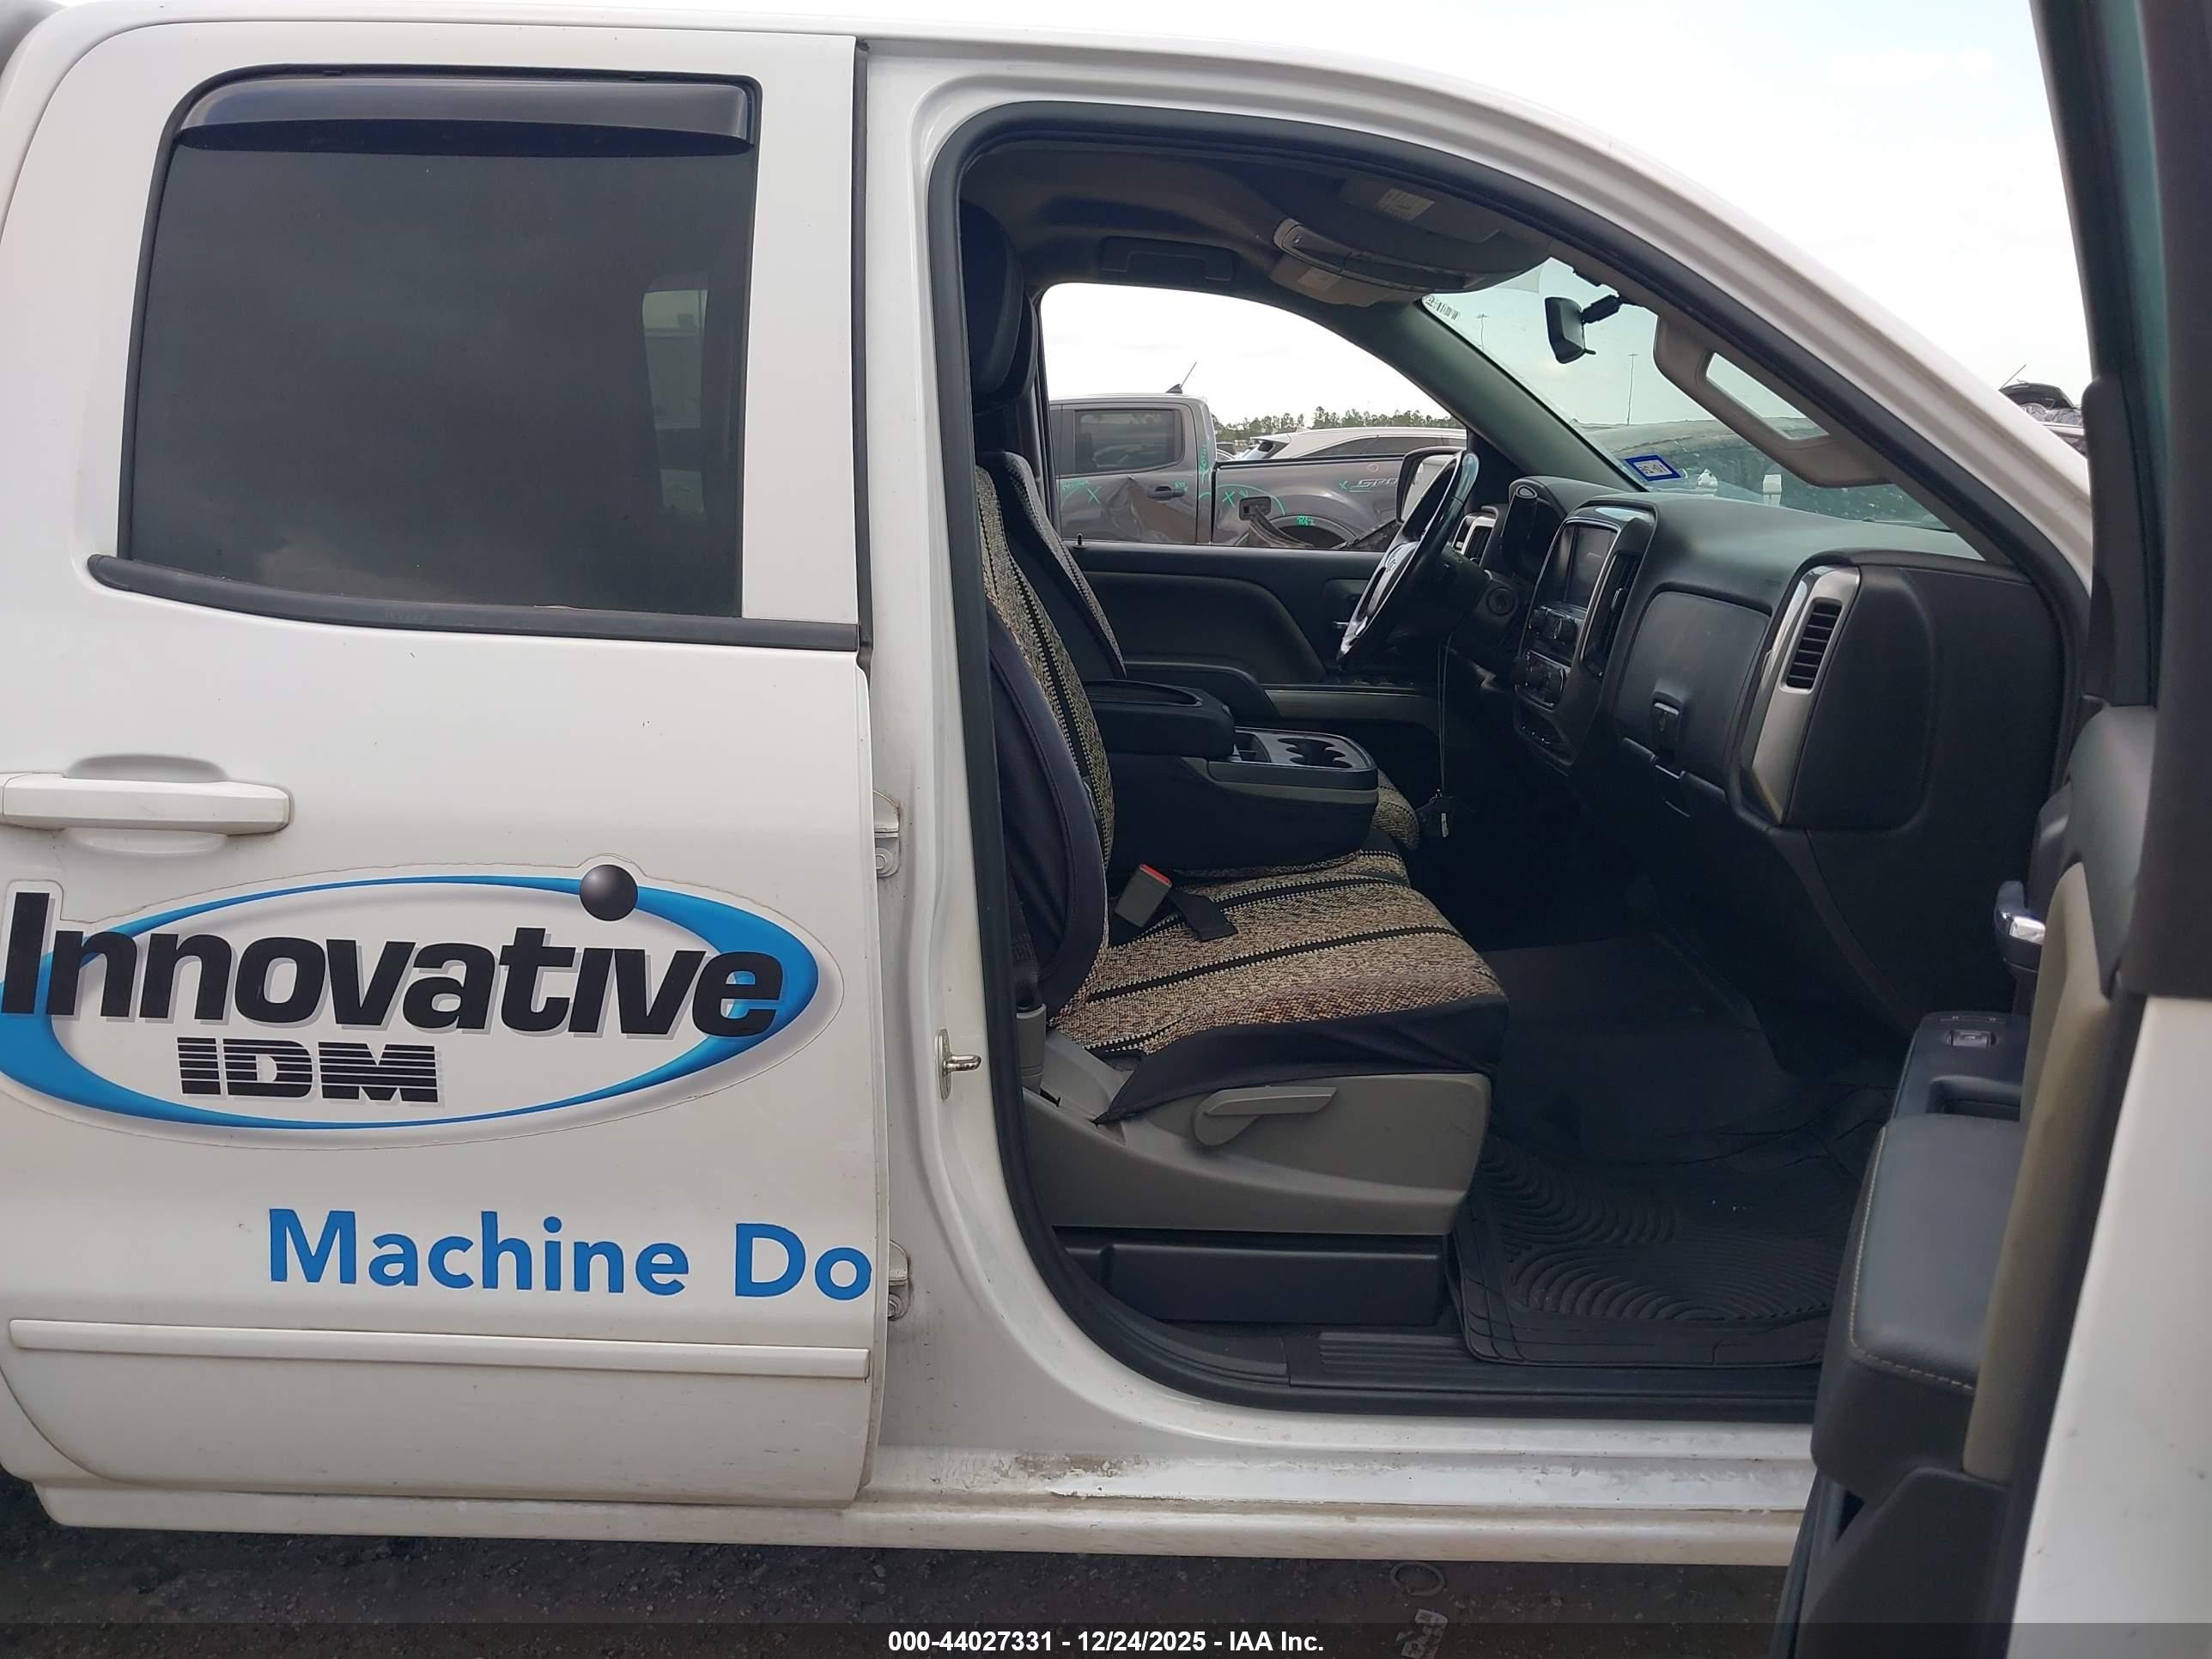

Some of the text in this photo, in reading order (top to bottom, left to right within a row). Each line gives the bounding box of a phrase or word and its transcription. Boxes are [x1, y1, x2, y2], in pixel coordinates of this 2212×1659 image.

[3, 867, 783, 1036] Innovative
[178, 1037, 438, 1103] IDM
[269, 1207, 872, 1300] Machine Do
